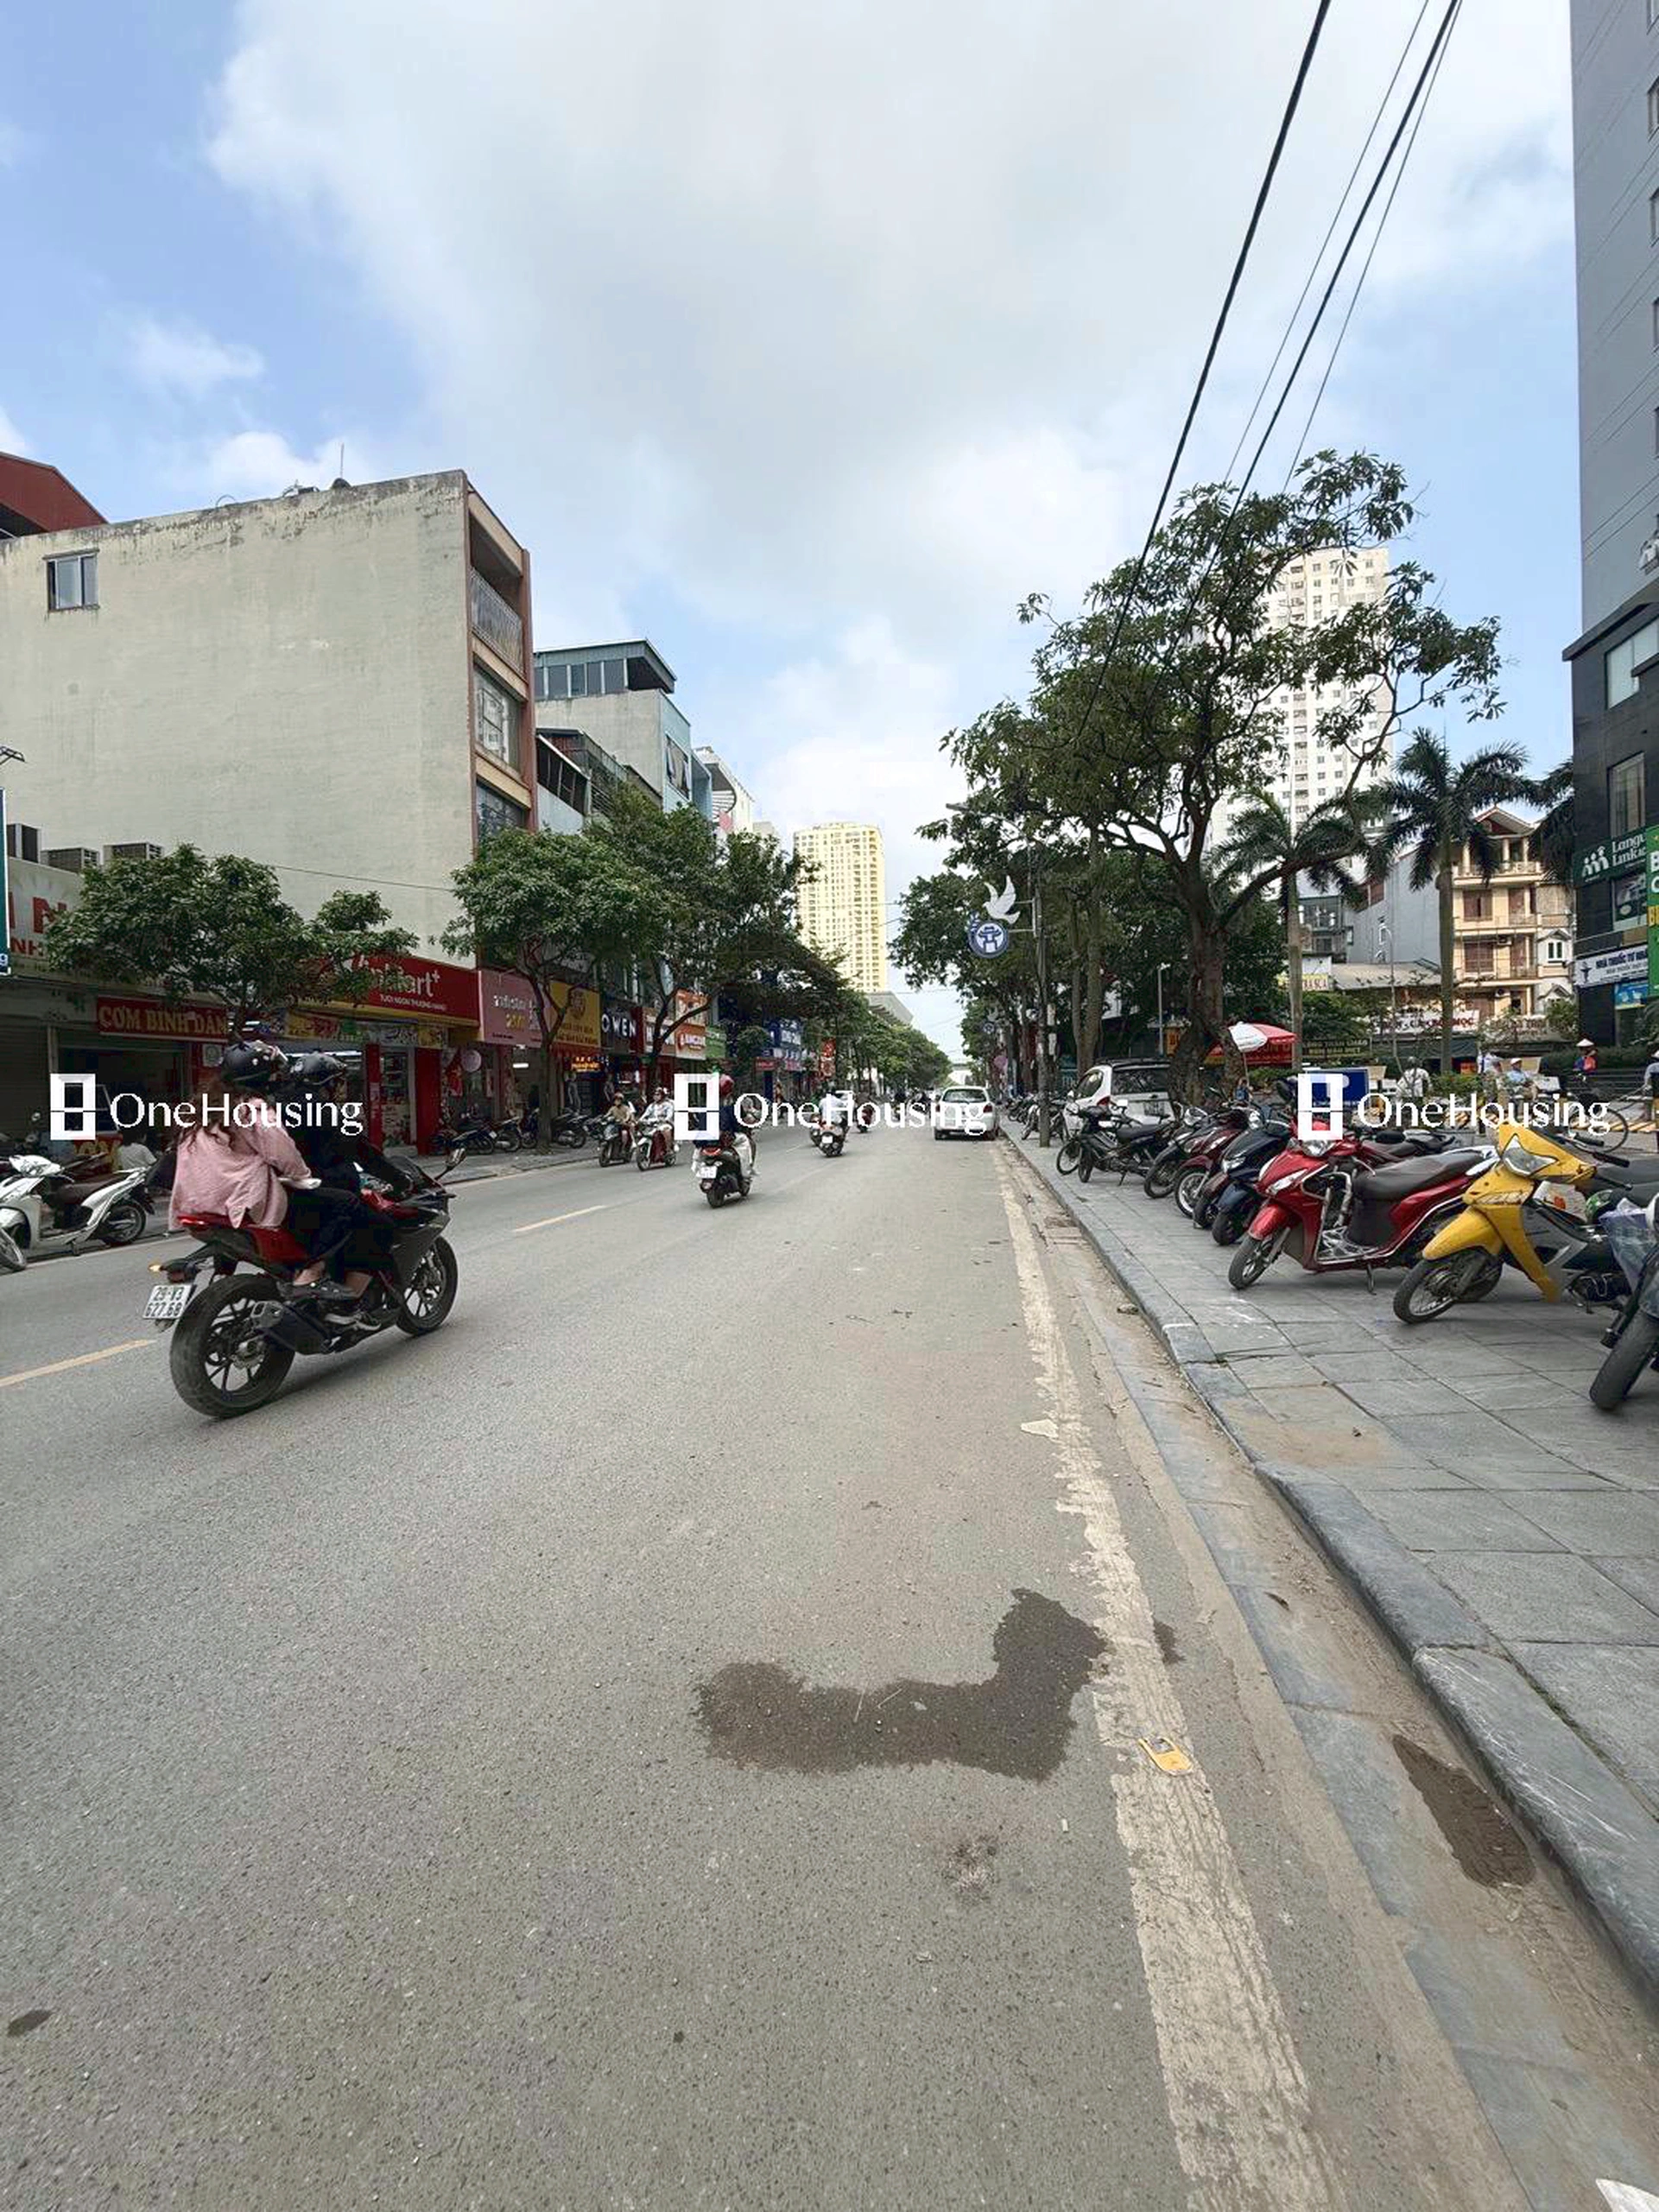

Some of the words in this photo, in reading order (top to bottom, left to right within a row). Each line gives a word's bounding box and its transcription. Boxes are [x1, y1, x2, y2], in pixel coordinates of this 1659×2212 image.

[98, 1005, 140, 1030] CƠM
[146, 1005, 190, 1032] BÌNH
[601, 1013, 636, 1037] OWEN
